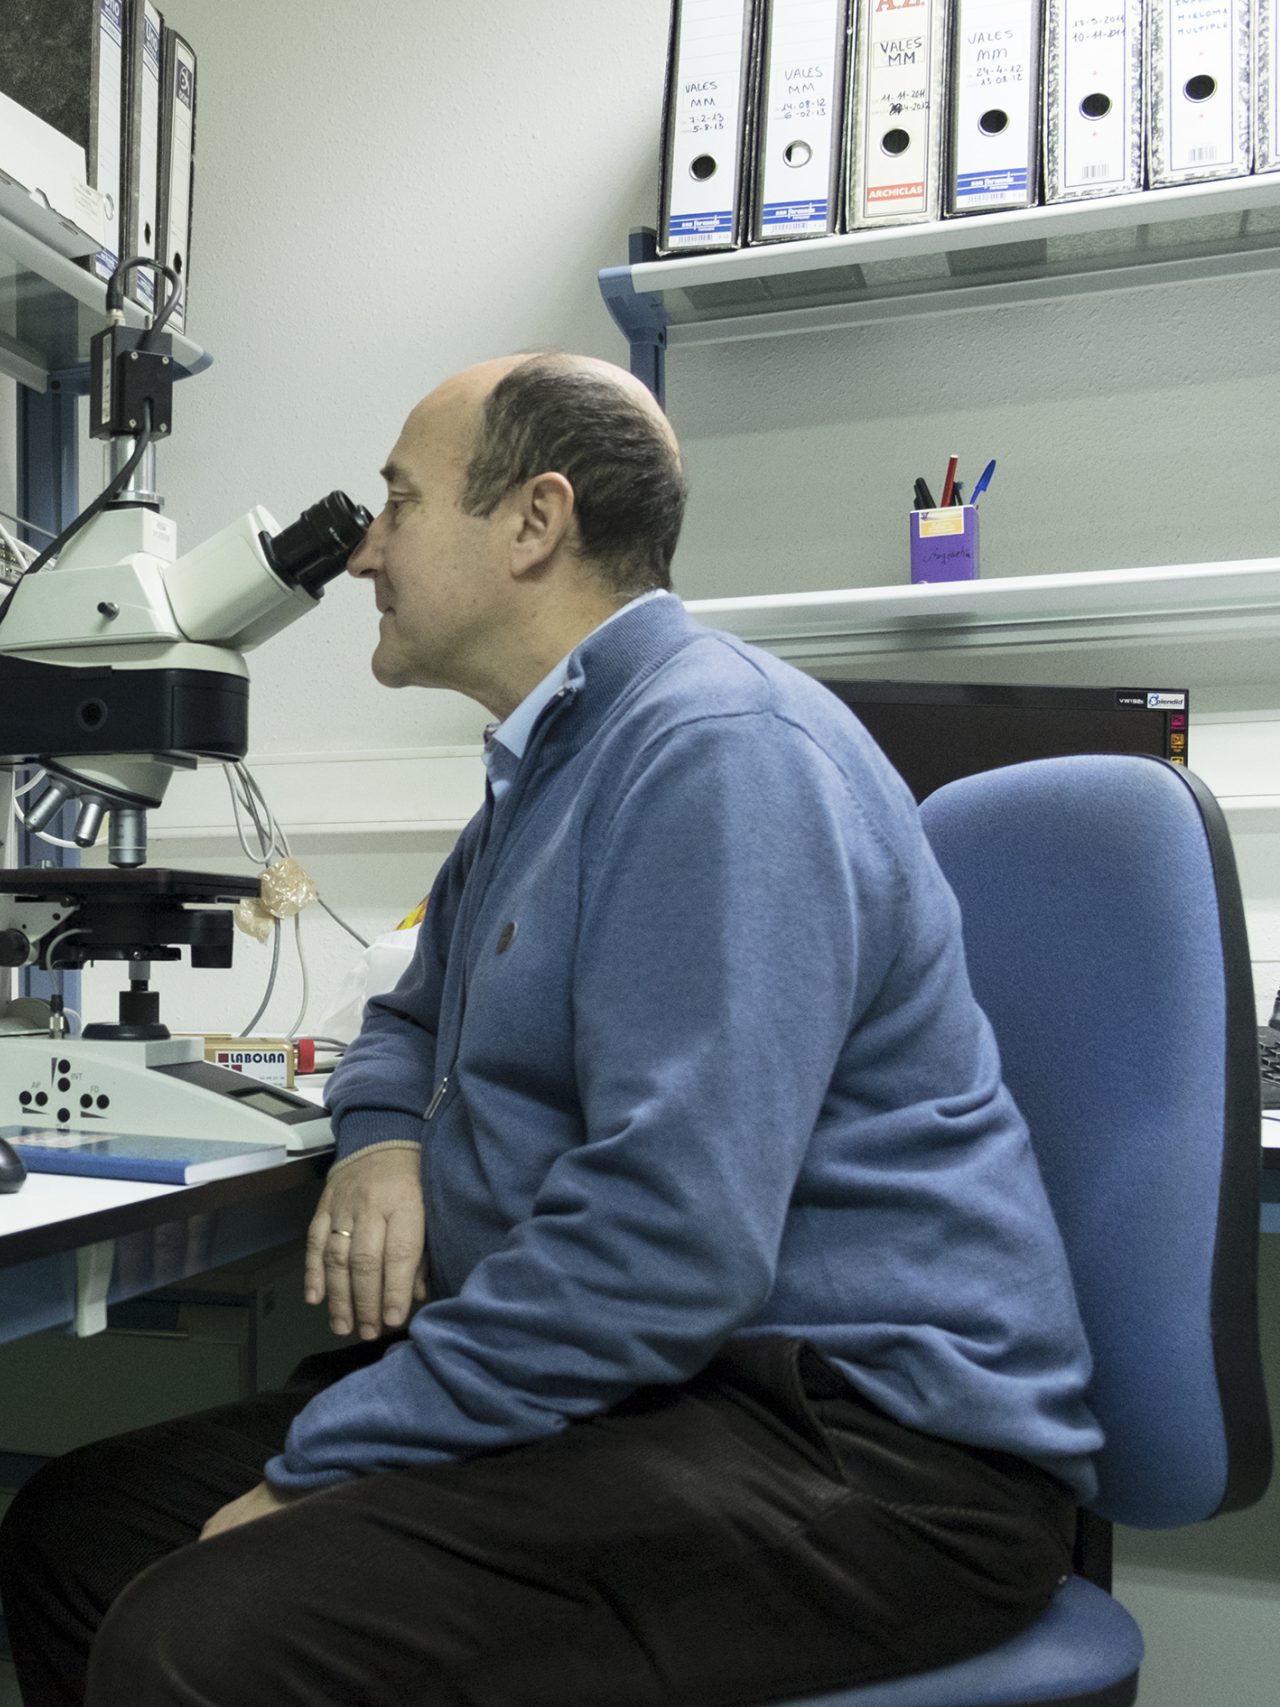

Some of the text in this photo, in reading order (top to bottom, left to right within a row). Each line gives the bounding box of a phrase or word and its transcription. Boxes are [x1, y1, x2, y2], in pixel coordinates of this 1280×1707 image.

[968, 30, 1013, 44] VALES
[881, 37, 922, 53] VALES
[888, 52, 915, 66] MM
[977, 48, 1007, 62] MM
[785, 66, 823, 80] VALES
[685, 81, 718, 94] VALES
[788, 83, 815, 94] MM
[691, 98, 716, 107] MM
[869, 186, 922, 198] ARCHICLAS
[231, 1053, 284, 1063] LABOLAN
